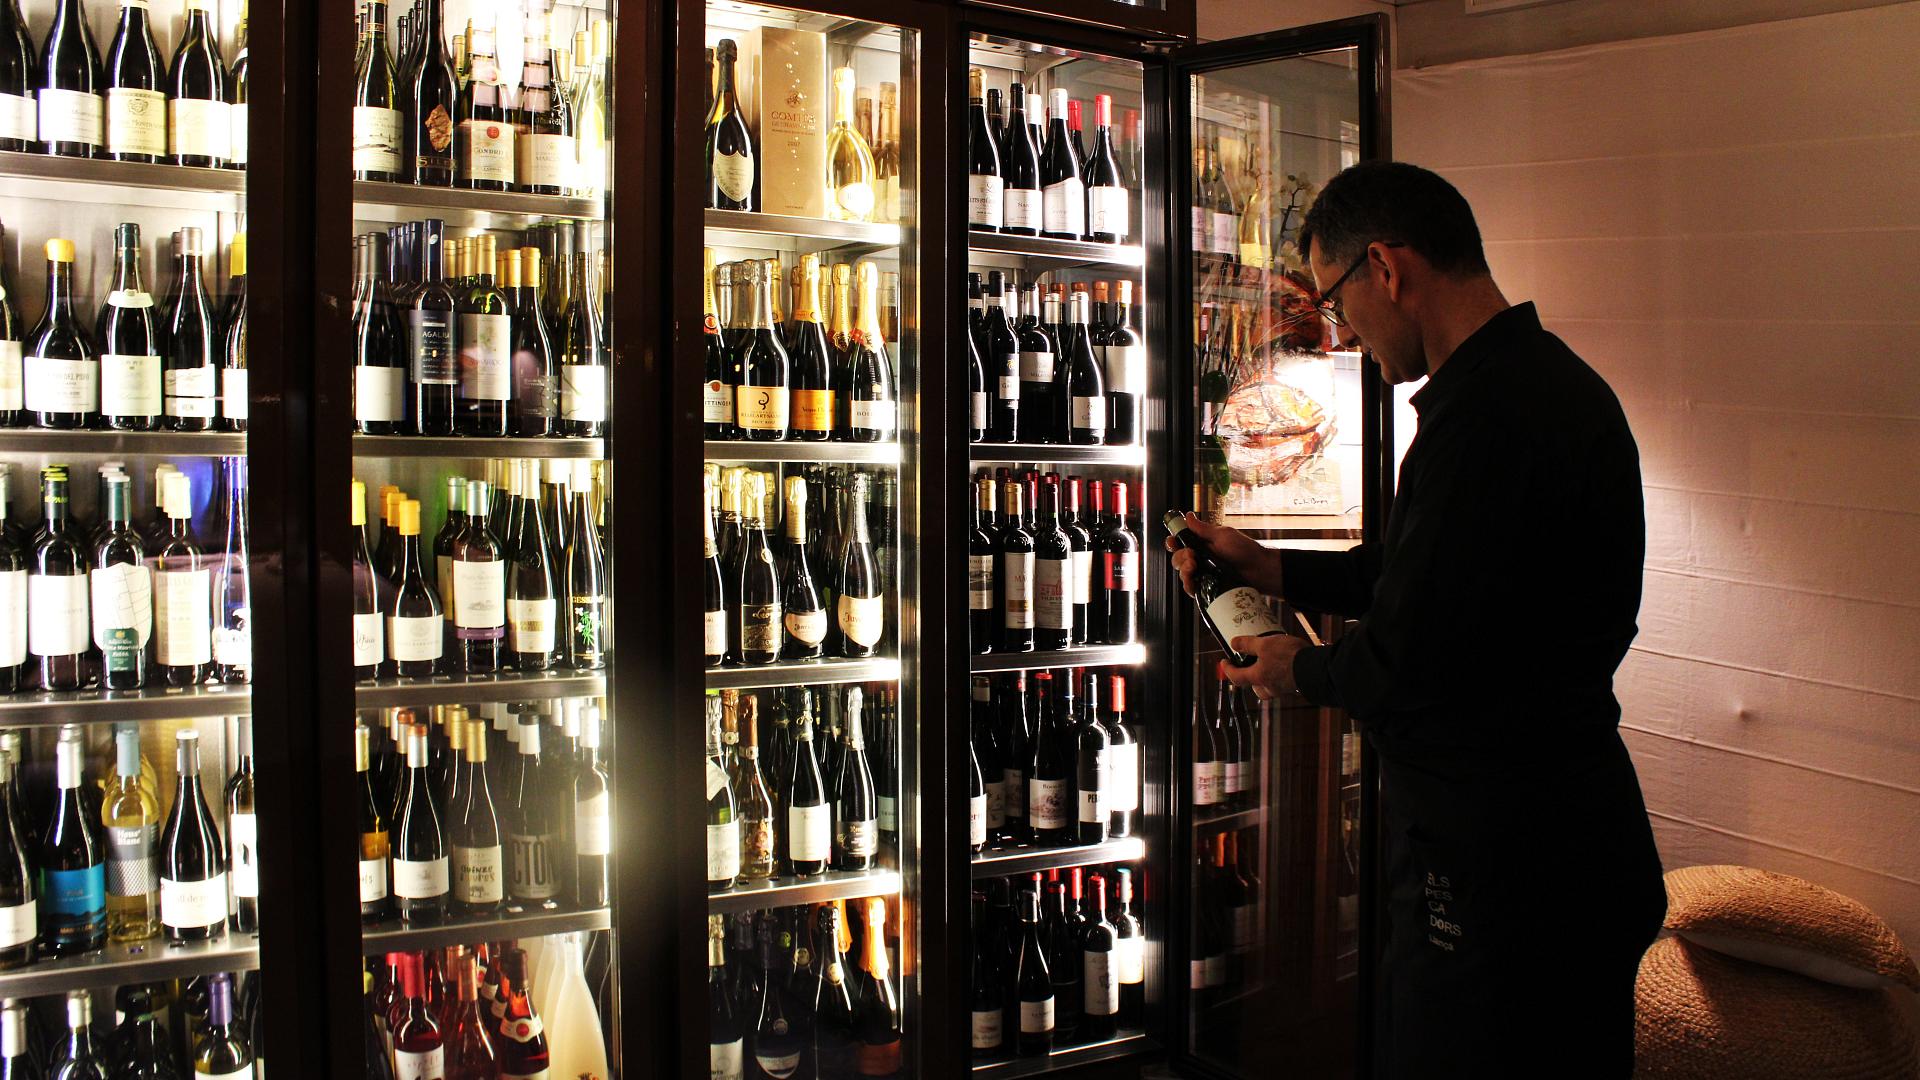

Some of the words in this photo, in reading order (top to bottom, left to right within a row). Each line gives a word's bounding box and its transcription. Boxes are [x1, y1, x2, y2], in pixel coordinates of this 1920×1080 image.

[1425, 888, 1454, 902] PES
[1427, 901, 1447, 916] CA
[1430, 914, 1462, 937] DORS
